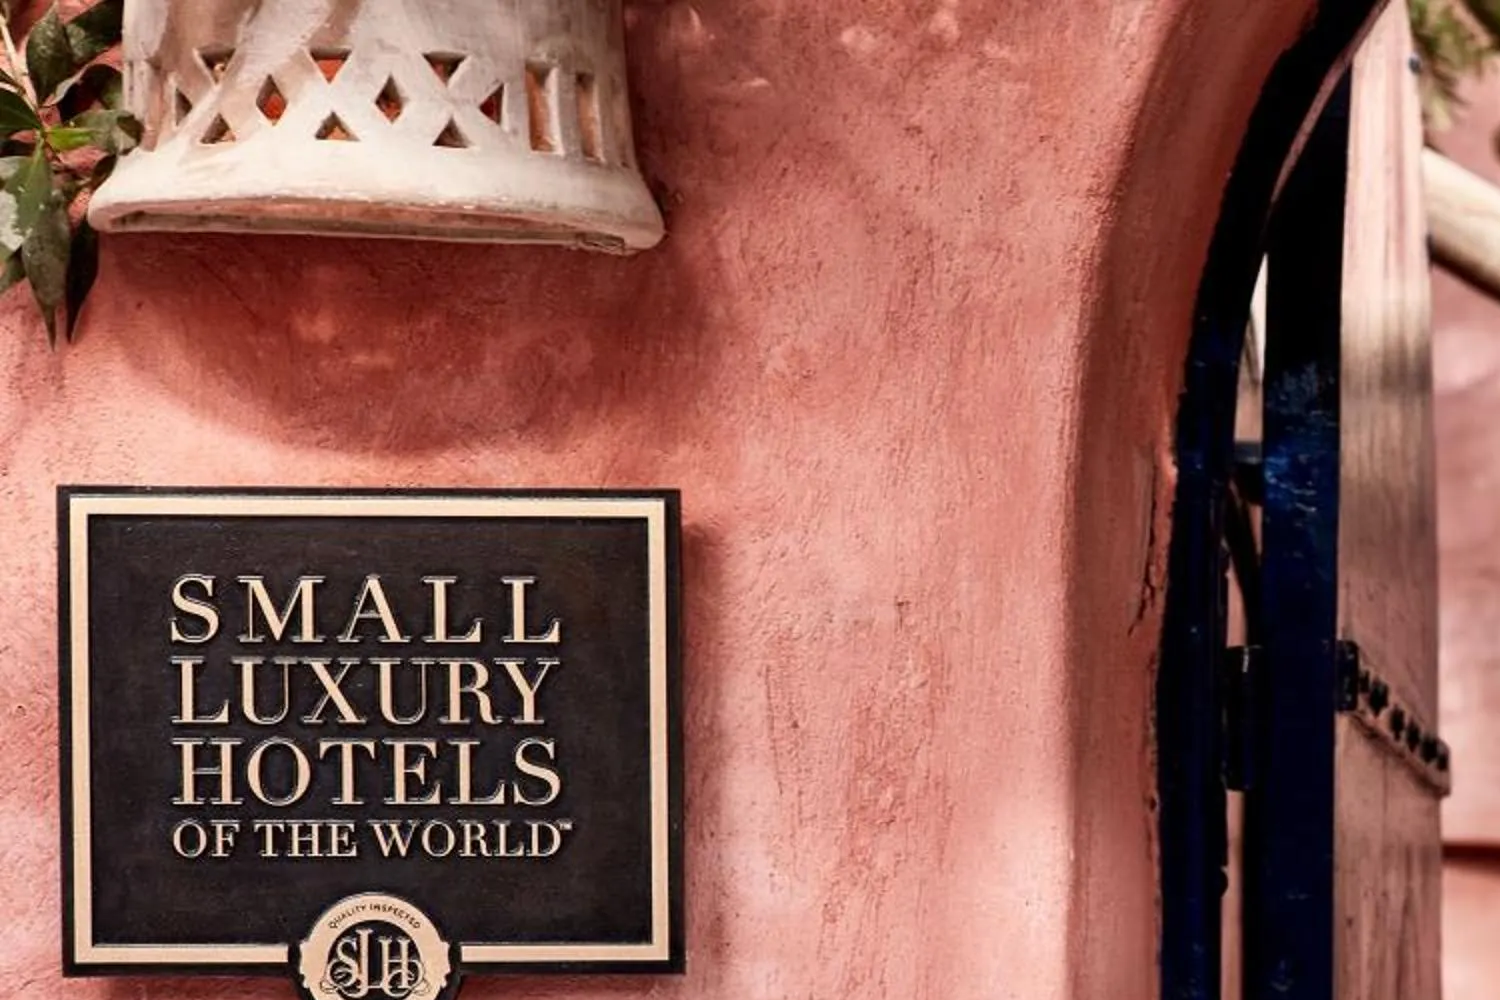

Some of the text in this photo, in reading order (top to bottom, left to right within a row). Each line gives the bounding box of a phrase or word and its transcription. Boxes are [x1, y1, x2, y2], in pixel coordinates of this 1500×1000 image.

[170, 573, 561, 644] SMALL
[170, 655, 561, 726] LUXURY
[171, 736, 562, 807] HOTELS
[172, 819, 241, 858] OF
[253, 819, 358, 858] THE
[328, 903, 421, 930] QUALITY INSPECTED
